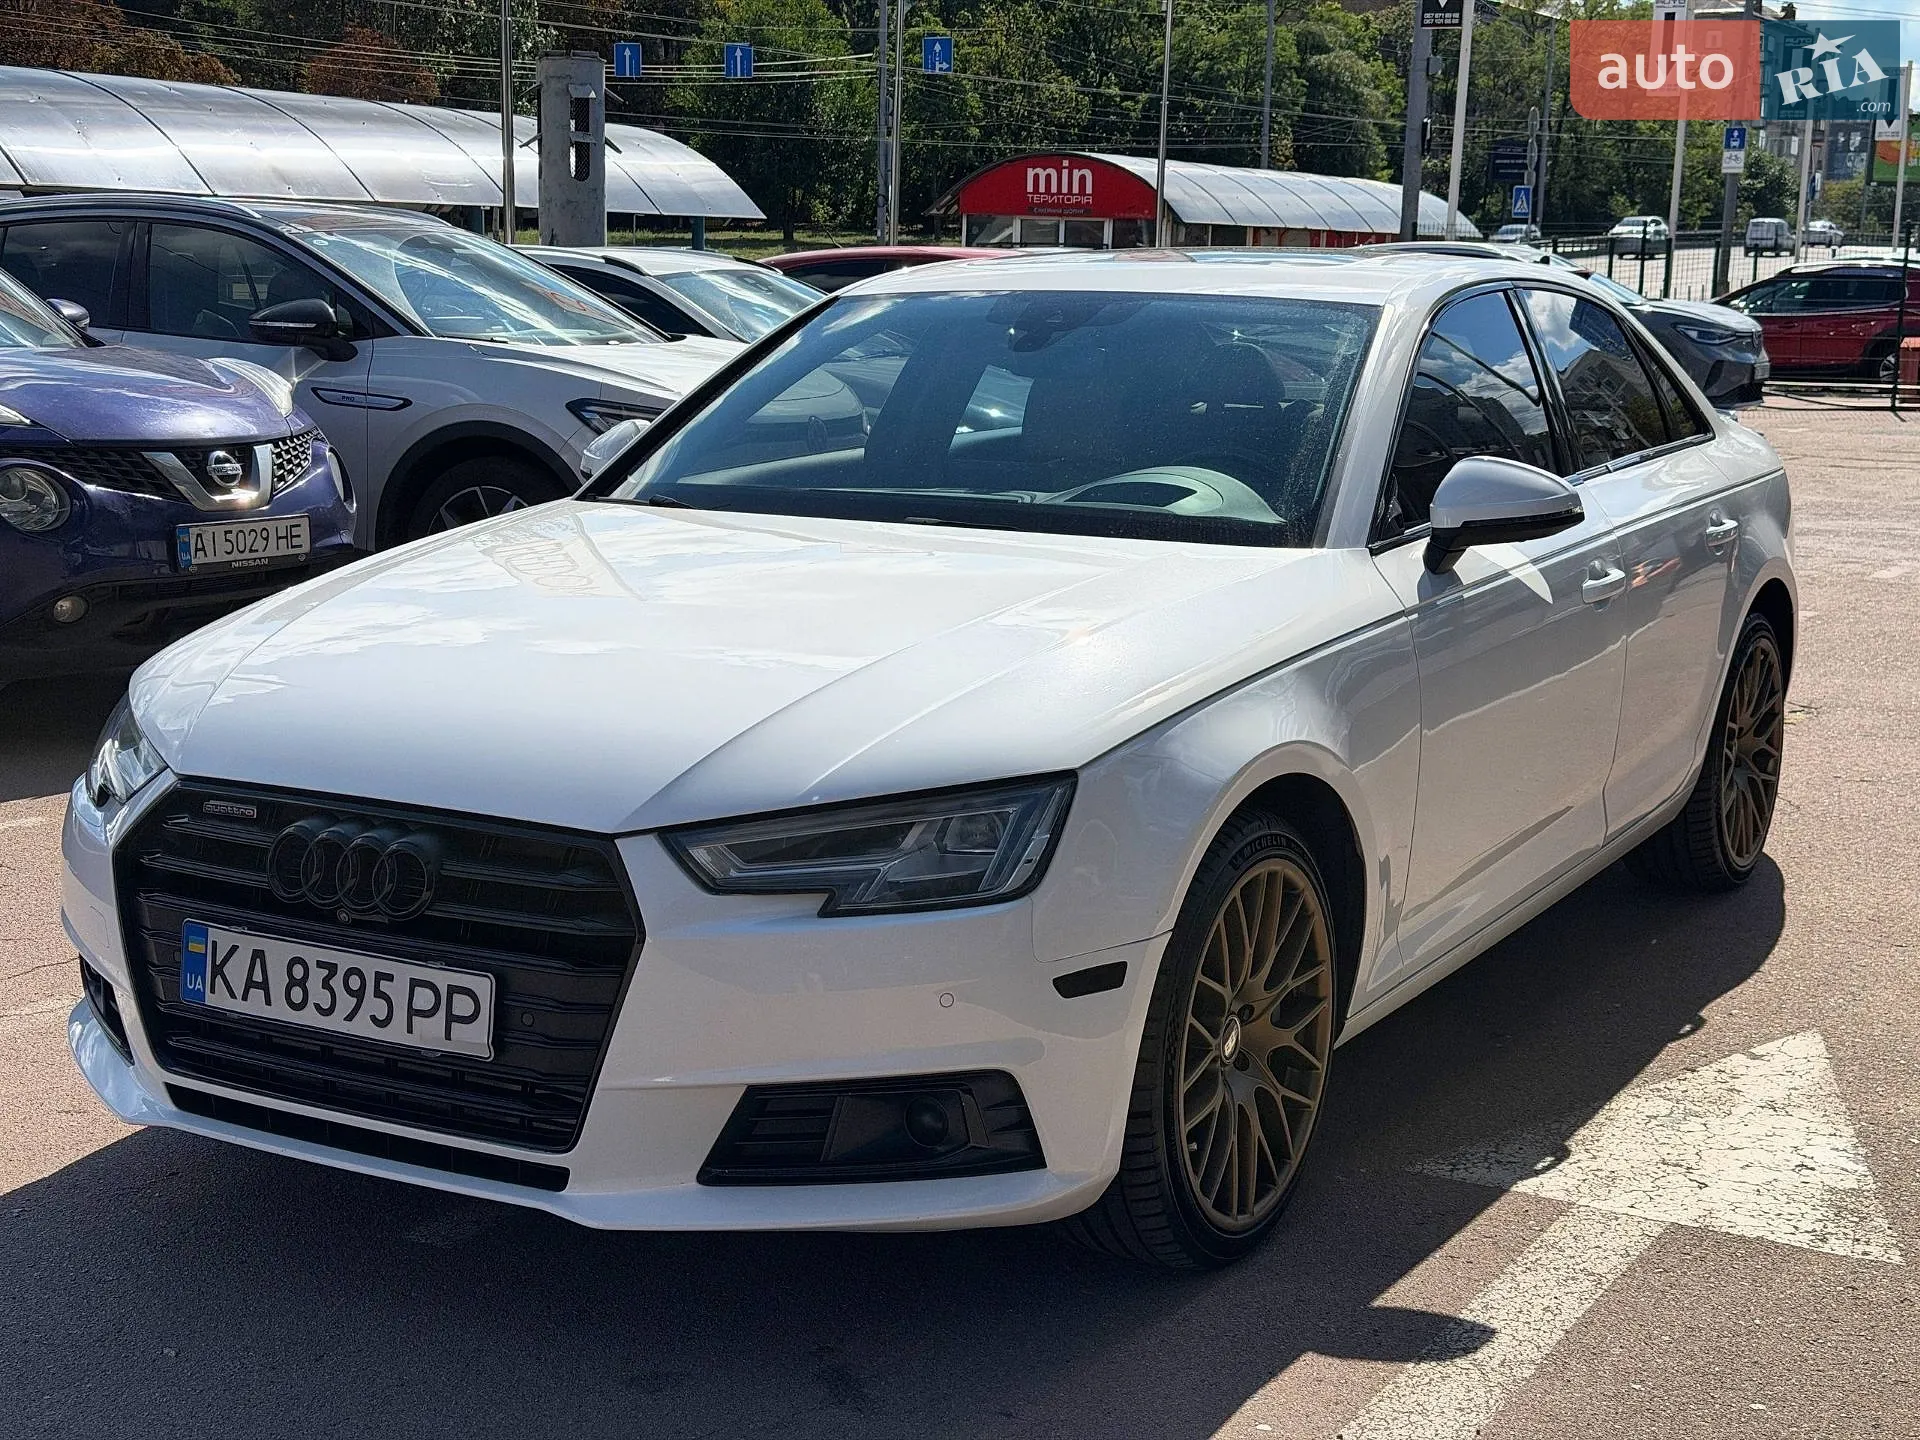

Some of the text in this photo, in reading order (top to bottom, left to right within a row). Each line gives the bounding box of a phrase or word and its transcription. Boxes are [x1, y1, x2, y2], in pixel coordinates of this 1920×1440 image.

[1027, 160, 1093, 194] min
[1027, 194, 1093, 205] ТЕРИТОРІЯ
[194, 524, 303, 559] AI 5029 HE
[231, 558, 269, 568] NISSAN
[203, 803, 255, 816] quattro
[186, 972, 204, 993] UA
[209, 940, 481, 1041] KA 8395 PP
